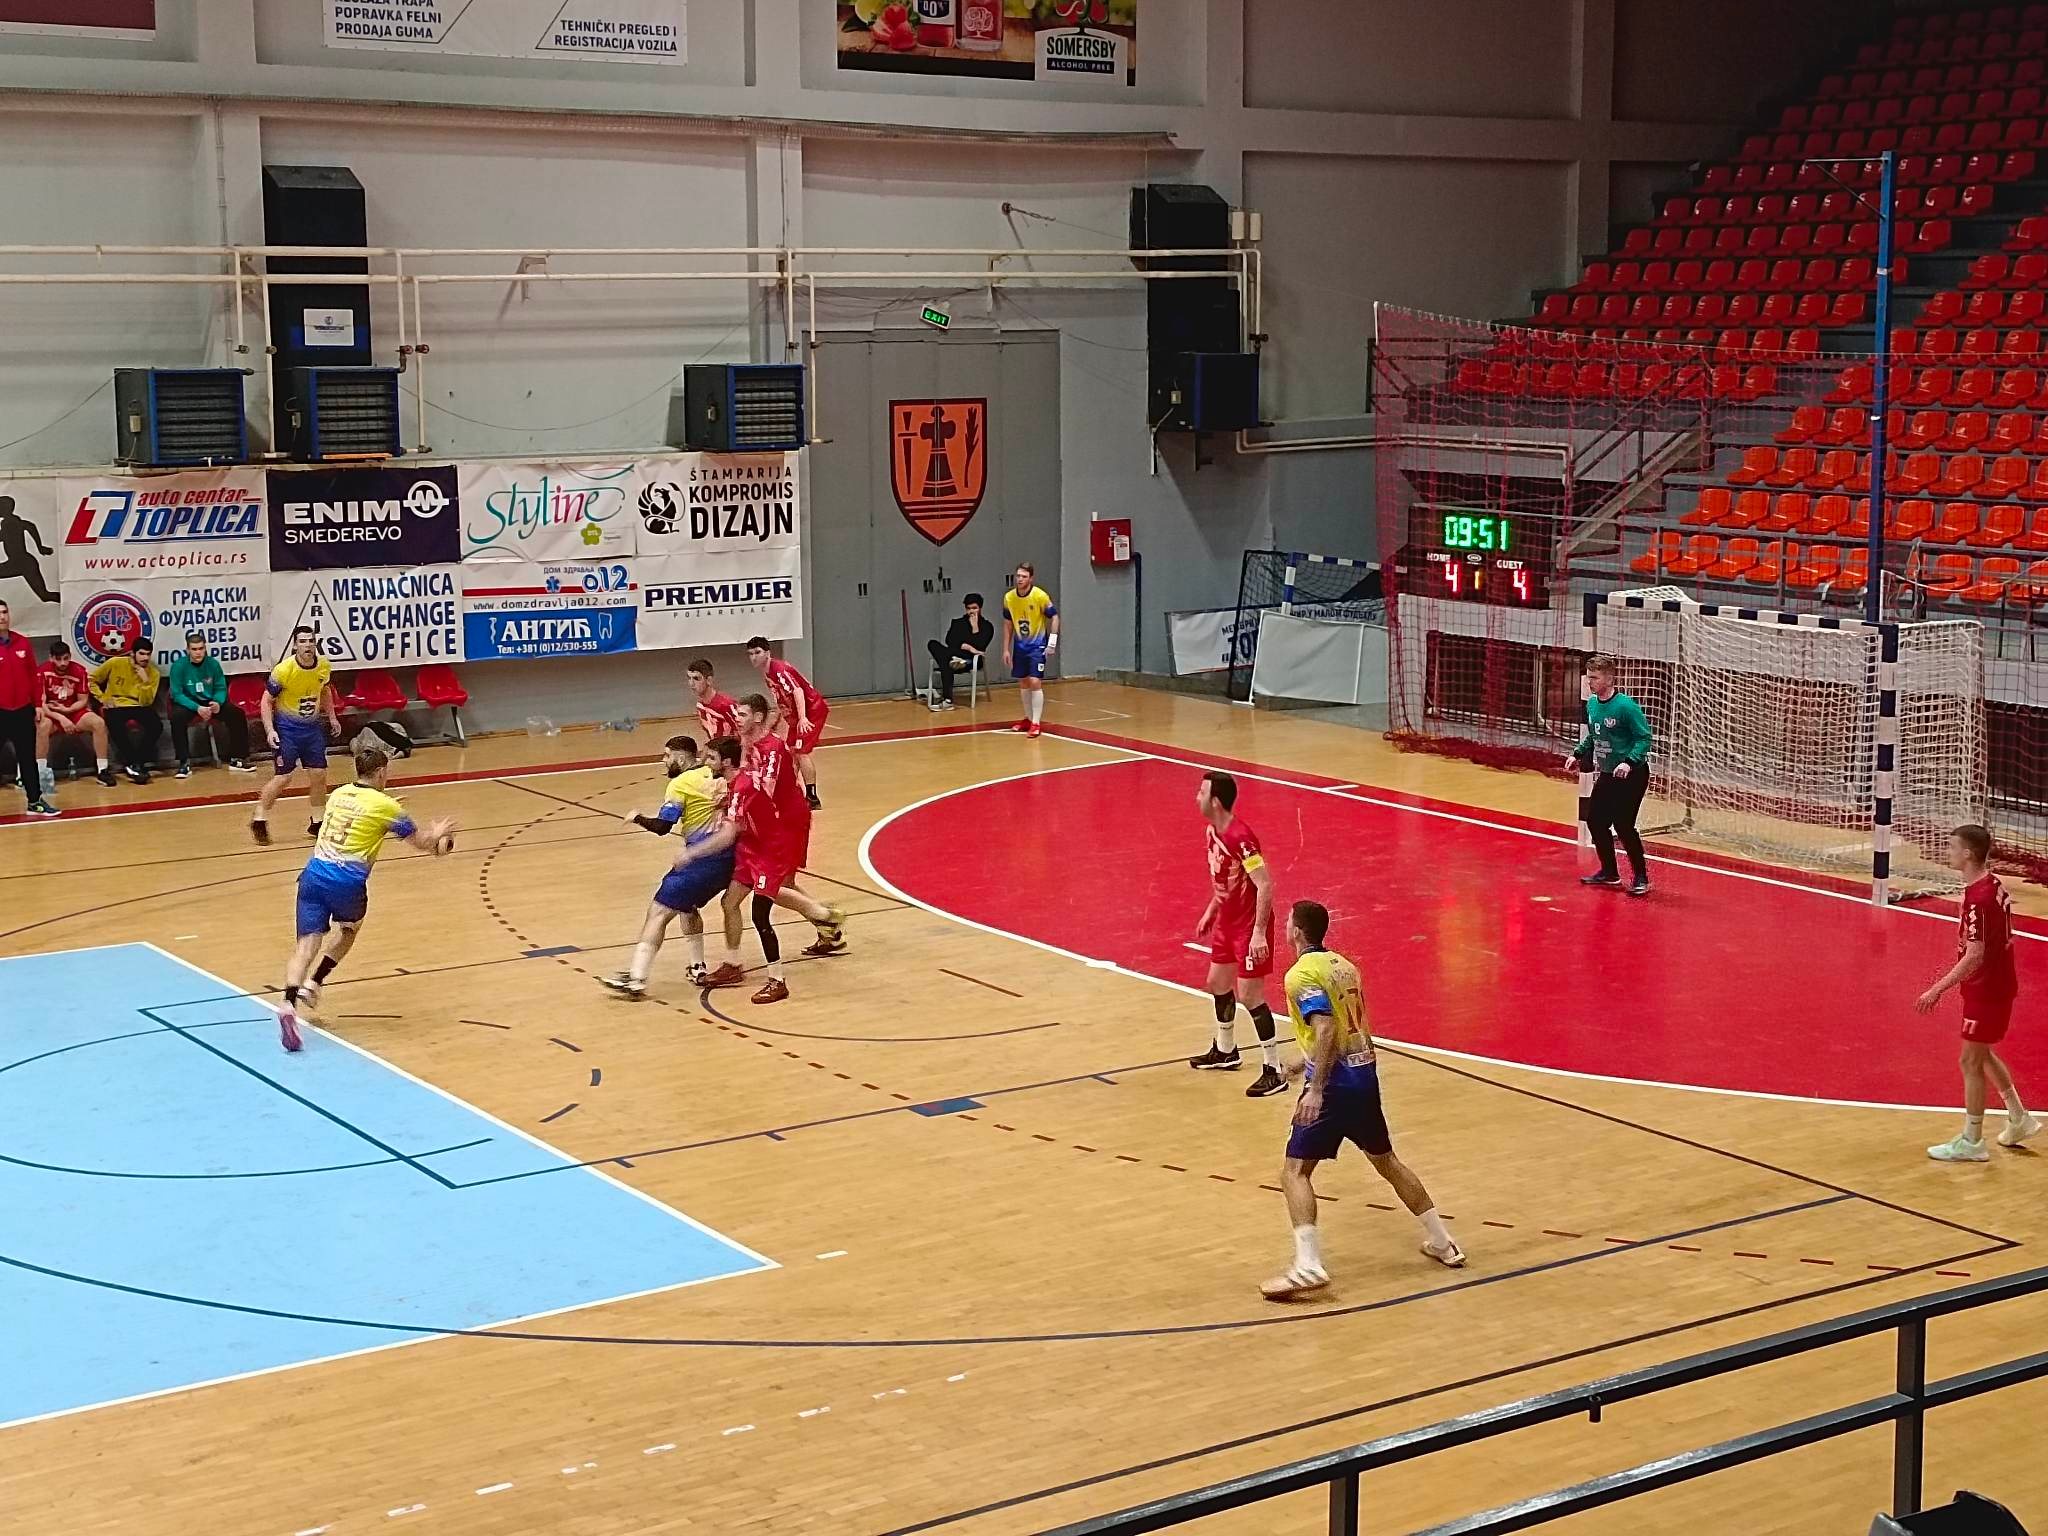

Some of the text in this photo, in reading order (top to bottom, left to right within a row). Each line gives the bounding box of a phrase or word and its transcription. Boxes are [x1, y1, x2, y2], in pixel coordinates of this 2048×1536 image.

[335, 6, 441, 24] POPRAVKA FELNI
[335, 22, 433, 38] PRODAJA GUMA
[560, 19, 677, 37] TEHNIČKI PREGLED I
[555, 35, 677, 52] REGISTRACIJA VOZILA
[1047, 36, 1117, 59] SOMERSBY
[1051, 61, 1111, 71] ALCOHOL FREE
[924, 310, 946, 324] EXIT
[690, 466, 792, 482] ŠTAMPARIJA
[137, 488, 249, 506] auto centar
[689, 482, 793, 503] KOMPROMIS
[131, 505, 259, 536] TOPLICA
[283, 500, 400, 524] ENIM
[690, 502, 793, 542] DIZAJN
[285, 526, 402, 544] SMEDEREVO
[1445, 516, 1510, 551] 09:51
[84, 551, 248, 569] www.actoplica.rs
[1497, 560, 1524, 570] GUEST
[332, 572, 454, 600] MENJAČNICA
[582, 564, 629, 593] 012
[1445, 563, 1527, 600] 4 1 4
[172, 587, 247, 607] ГРАДСКИ
[473, 597, 627, 610] www.domzdravlja012.com
[645, 580, 792, 607] PREMIJER
[159, 606, 261, 628] ФУДБАЛСКИ
[349, 601, 456, 632] EXCHANGE
[673, 606, 766, 619] POŽAREVAC
[501, 618, 591, 641] АНТИЋ
[158, 644, 262, 665] ПОРЕВАЦ
[362, 628, 457, 661] OFFICE
[516, 643, 537, 653] +381
[757, 875, 766, 889] 9
